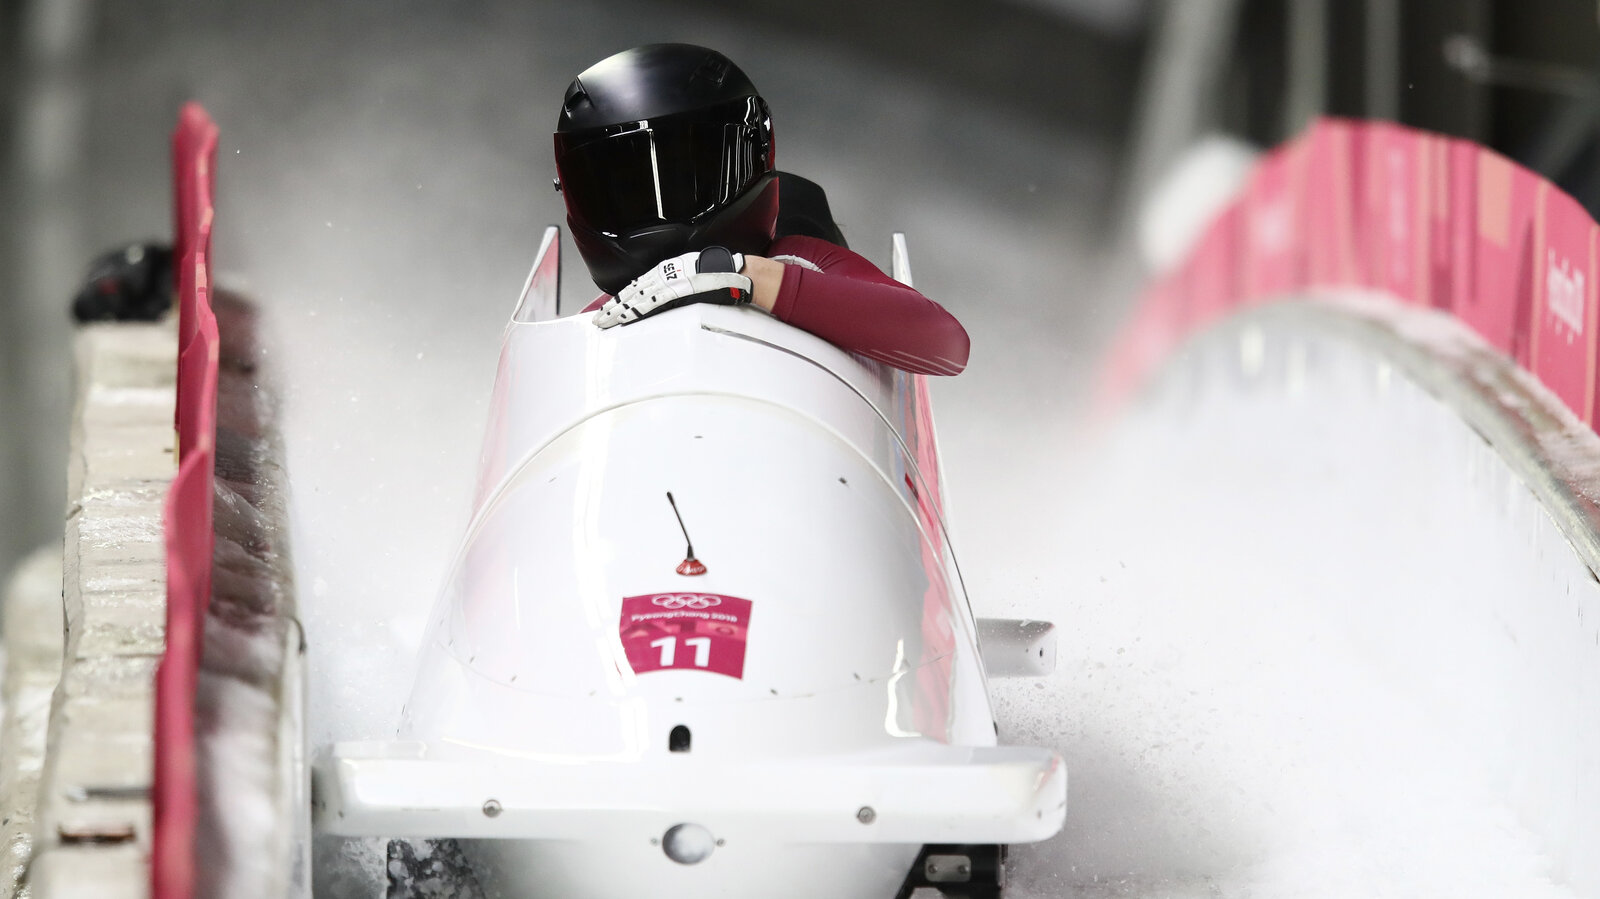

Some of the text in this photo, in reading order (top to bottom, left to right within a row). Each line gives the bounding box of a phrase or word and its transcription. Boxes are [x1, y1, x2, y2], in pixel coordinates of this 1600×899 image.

[631, 610, 738, 623] PyeongChang 2018
[650, 636, 711, 667] 11
